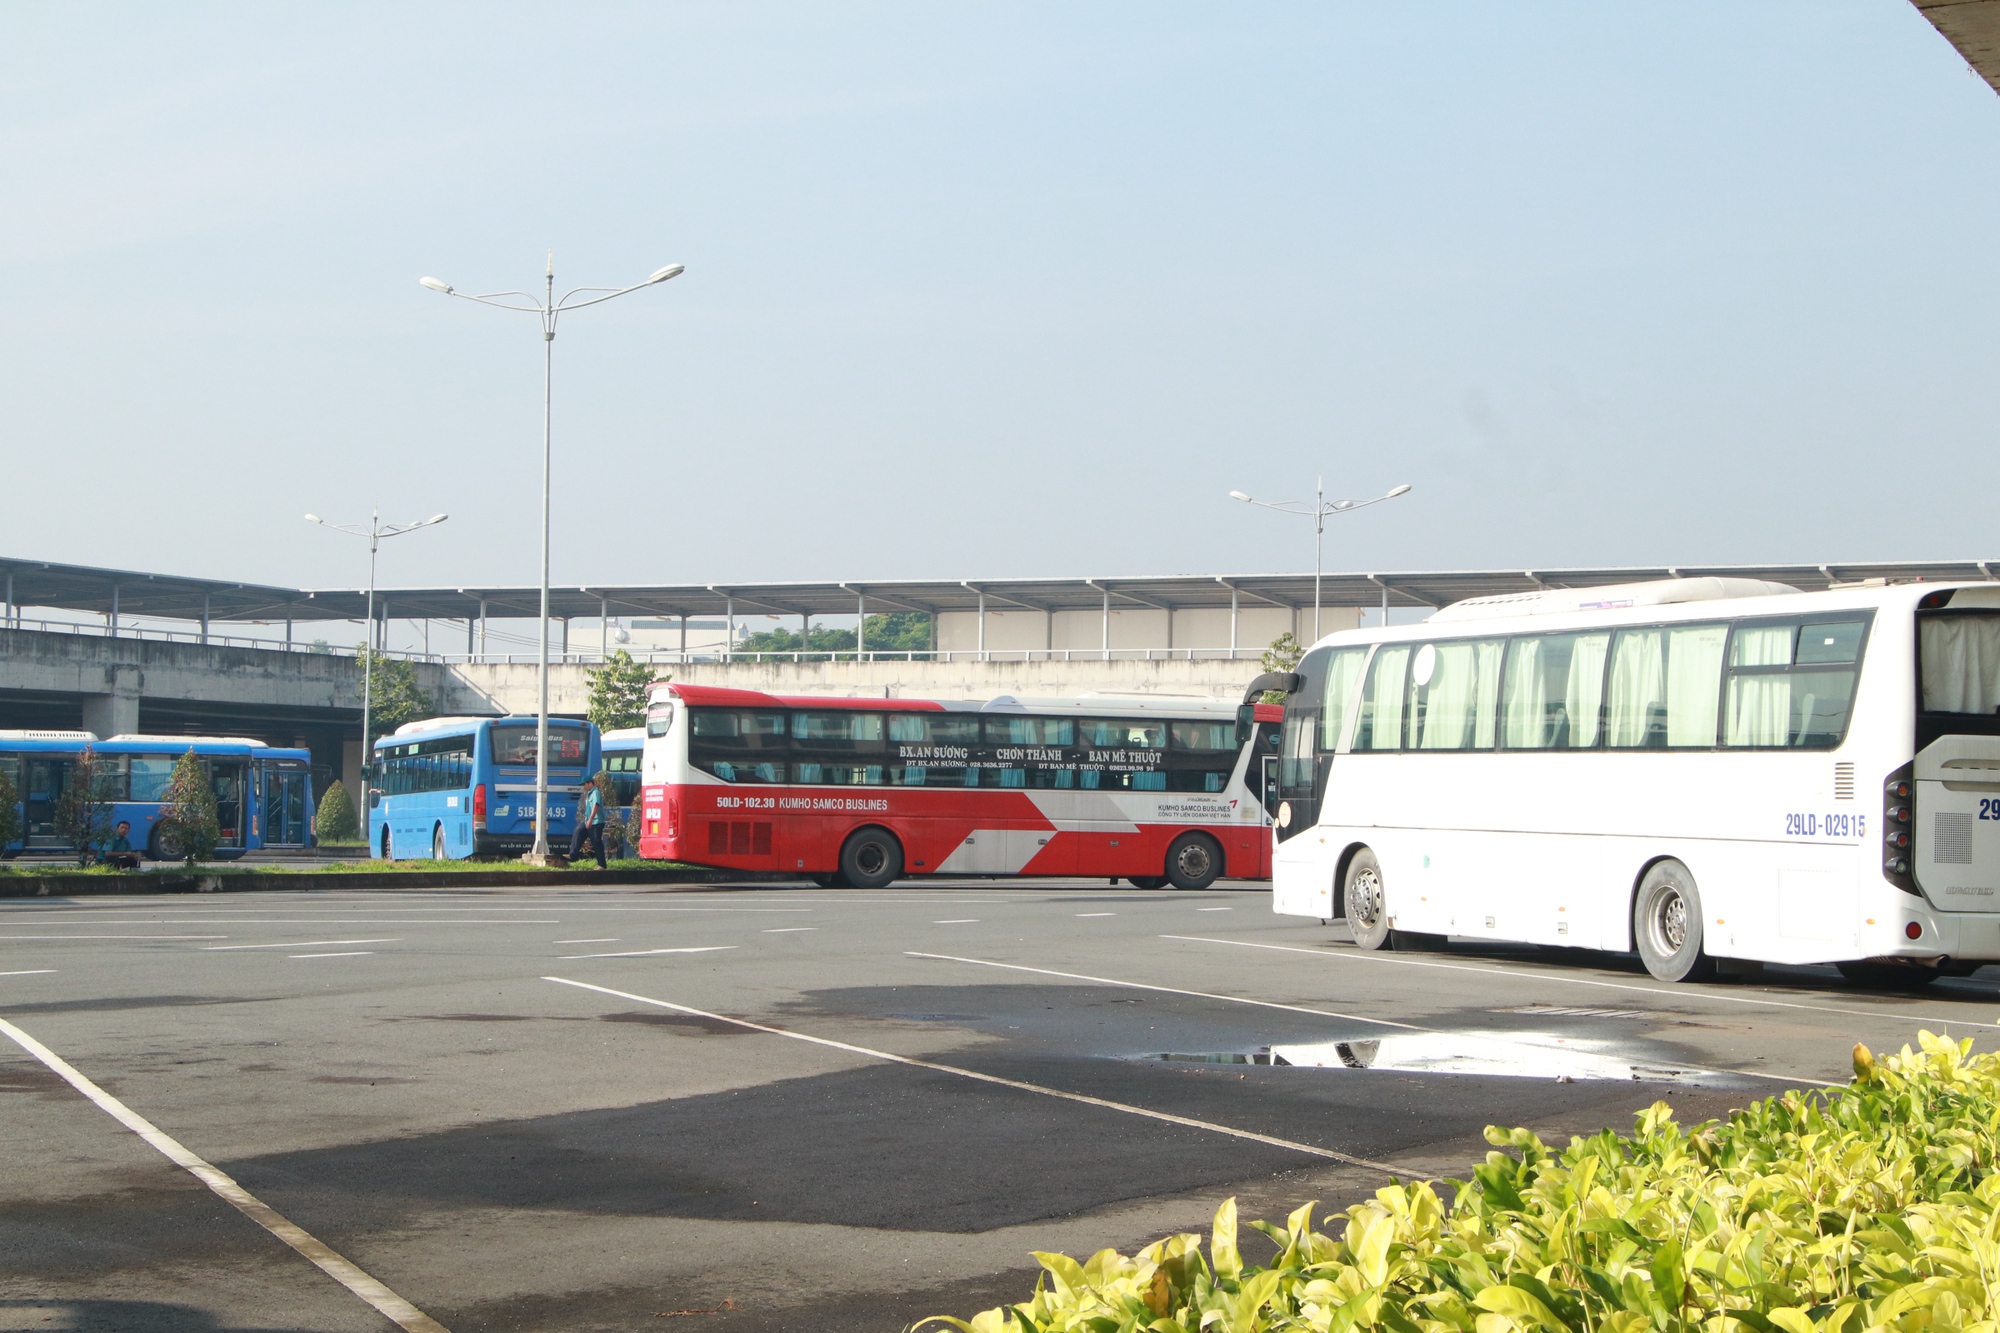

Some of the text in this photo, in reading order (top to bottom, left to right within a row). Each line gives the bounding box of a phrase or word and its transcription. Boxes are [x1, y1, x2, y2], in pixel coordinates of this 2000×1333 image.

[899, 745, 1162, 765] BX.AN SƯƠNG CHƠN THÀNH BAN MÊ THUỘT
[717, 796, 888, 811] 50LD-102.30 KUMHO SAMCO BUSLINES
[1180, 804, 1201, 812] SAMCO
[1786, 813, 1865, 837] 29LD-02915
